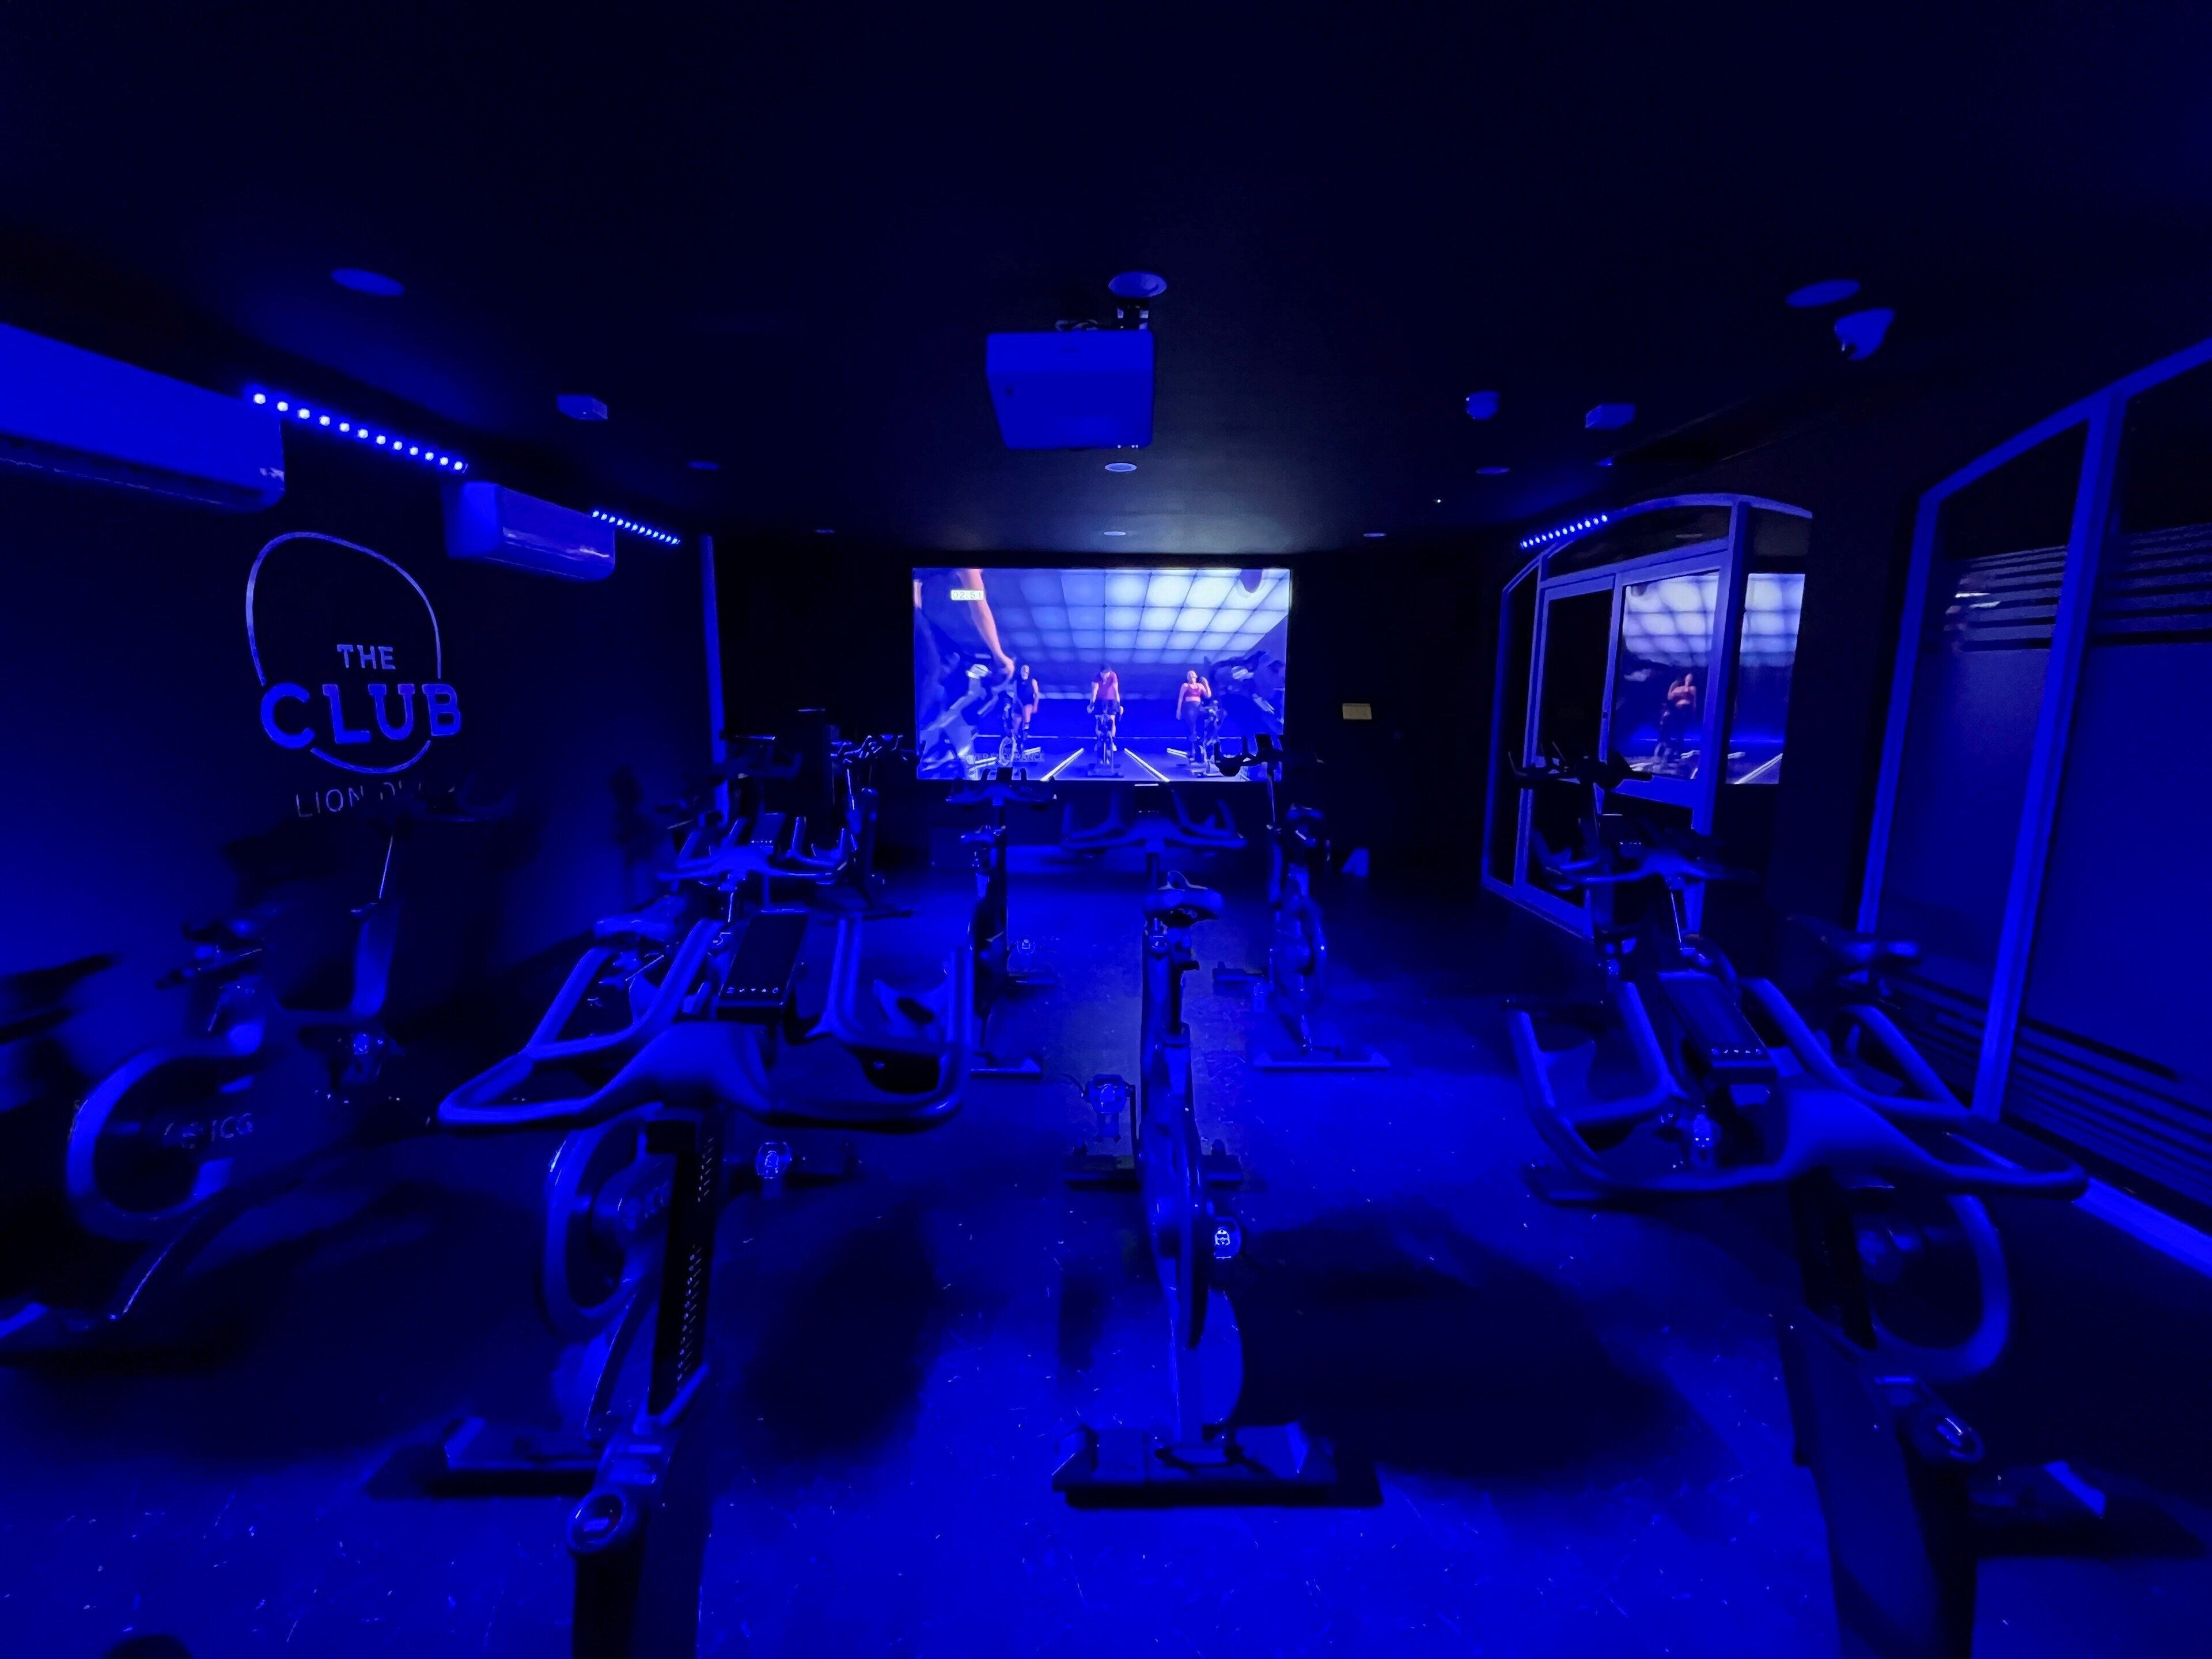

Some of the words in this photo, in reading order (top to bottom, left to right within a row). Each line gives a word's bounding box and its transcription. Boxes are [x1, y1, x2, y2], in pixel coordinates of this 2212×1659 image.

[336, 643, 396, 670] THE
[260, 682, 462, 749] CLUB
[211, 1112, 253, 1142] ICG
